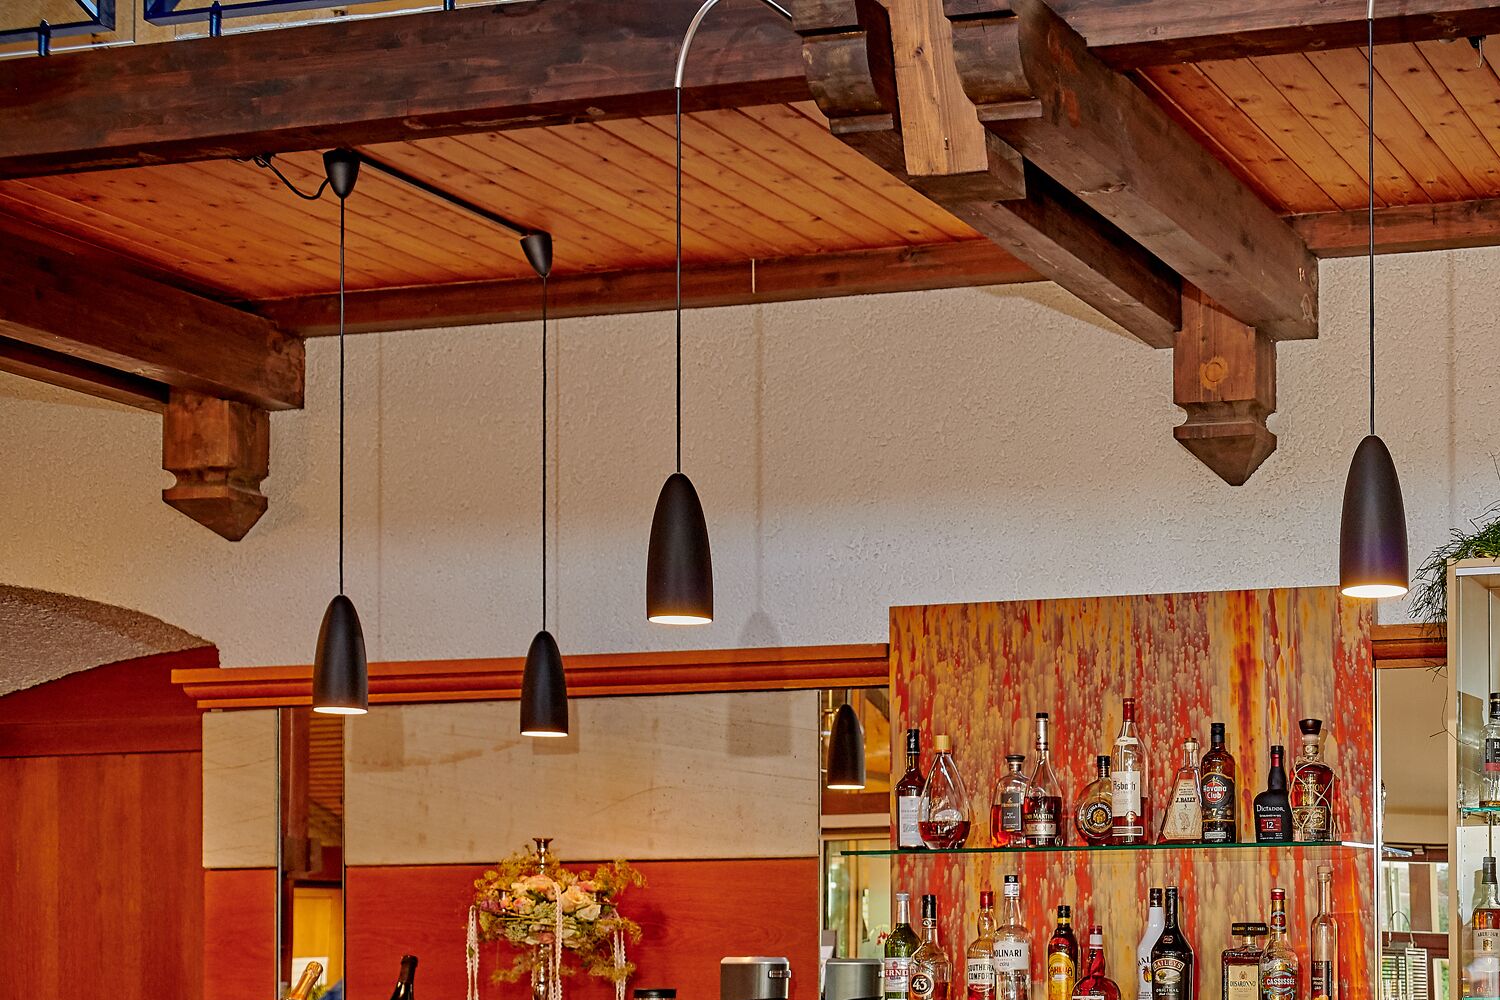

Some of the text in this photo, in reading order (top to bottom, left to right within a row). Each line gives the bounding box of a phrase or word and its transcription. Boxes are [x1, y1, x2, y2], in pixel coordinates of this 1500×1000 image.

[1207, 791, 1222, 799] Club
[1033, 812, 1054, 820] MARTIN
[1266, 821, 1275, 829] 12
[1154, 959, 1182, 969] BAILEYS
[912, 978, 928, 991] 43
